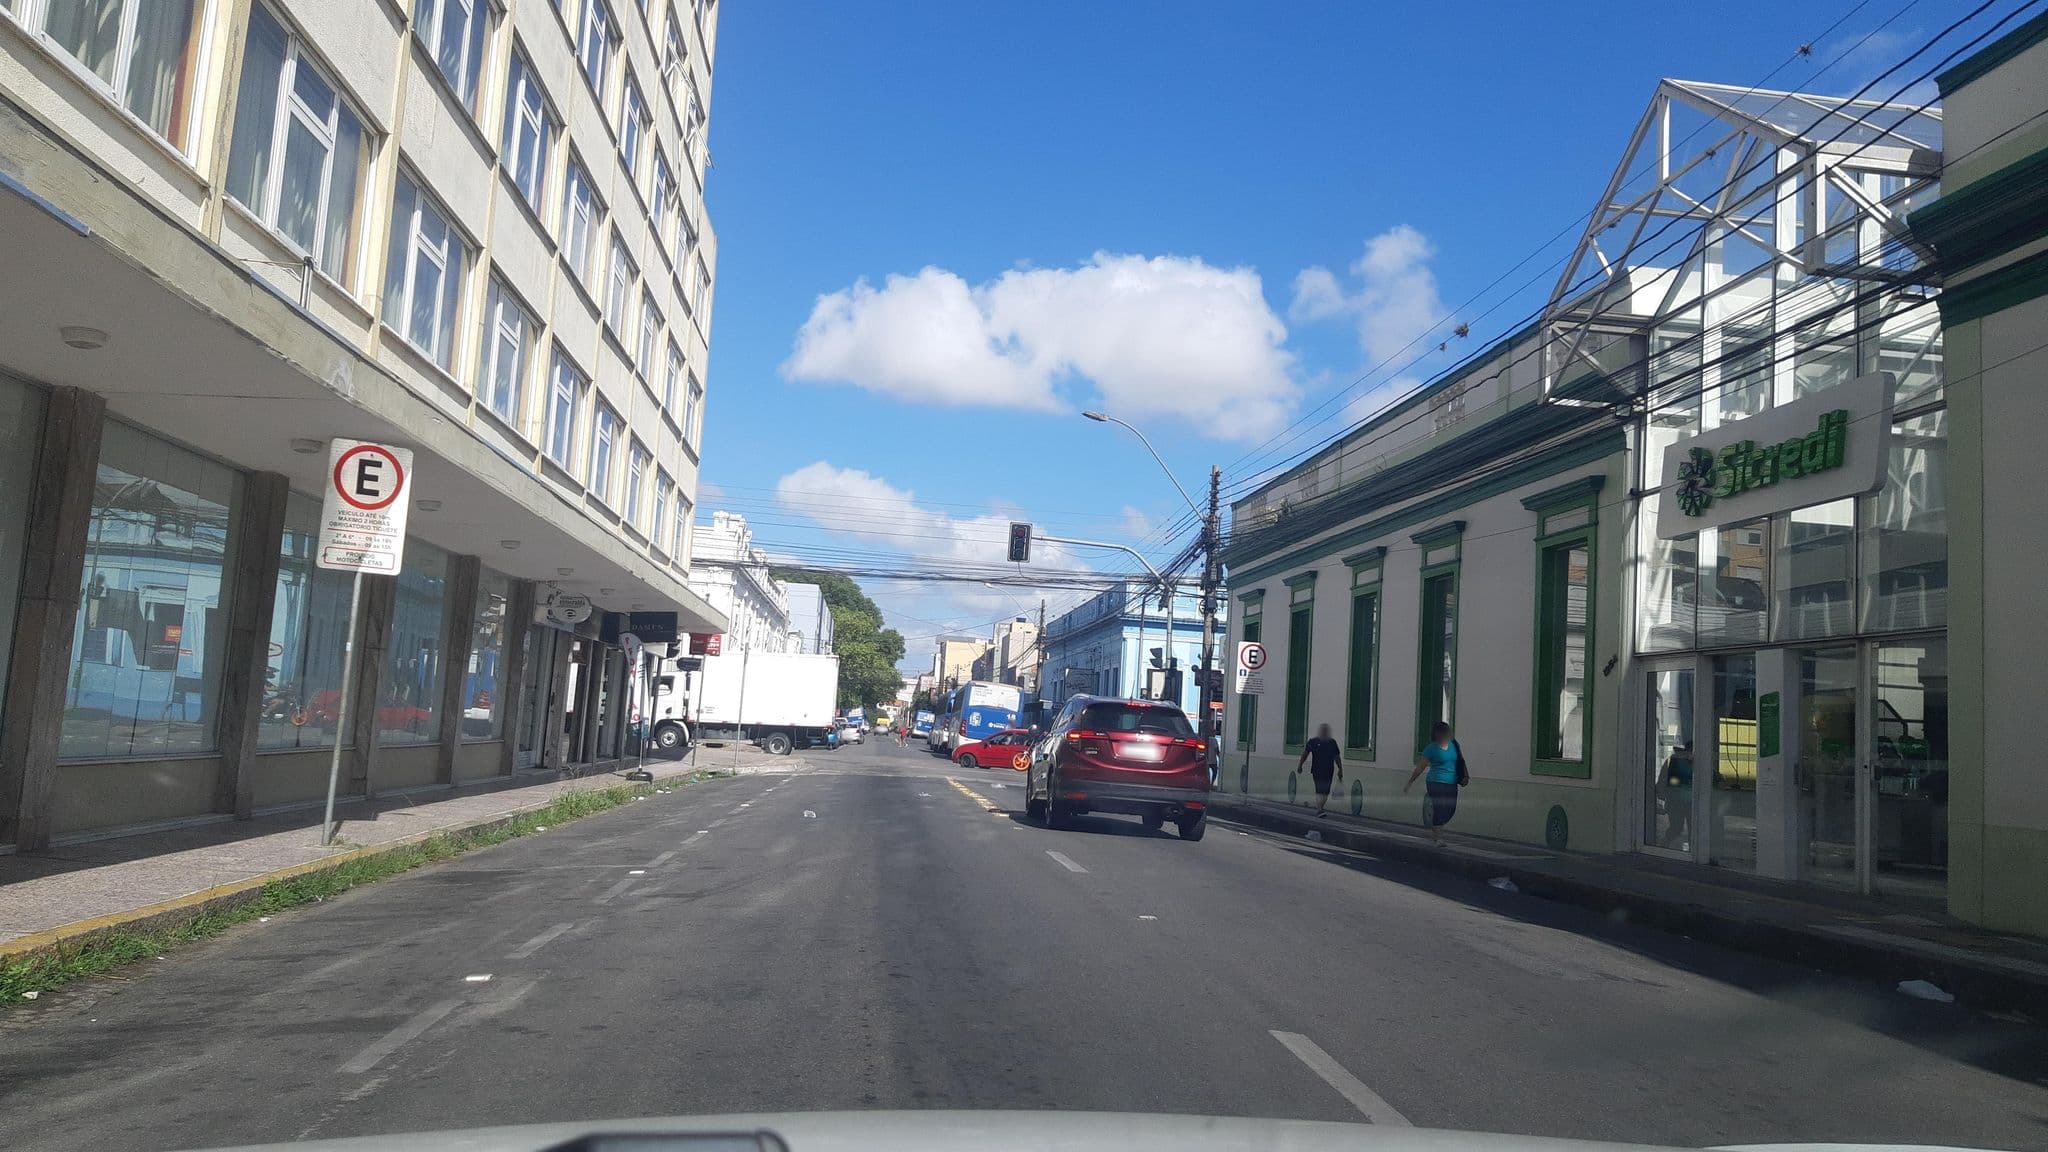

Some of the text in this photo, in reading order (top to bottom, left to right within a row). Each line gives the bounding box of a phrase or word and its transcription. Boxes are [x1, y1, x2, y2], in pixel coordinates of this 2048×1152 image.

[1711, 409, 1848, 498] Sicredi
[356, 458, 382, 497] E
[1248, 649, 1258, 664] E
